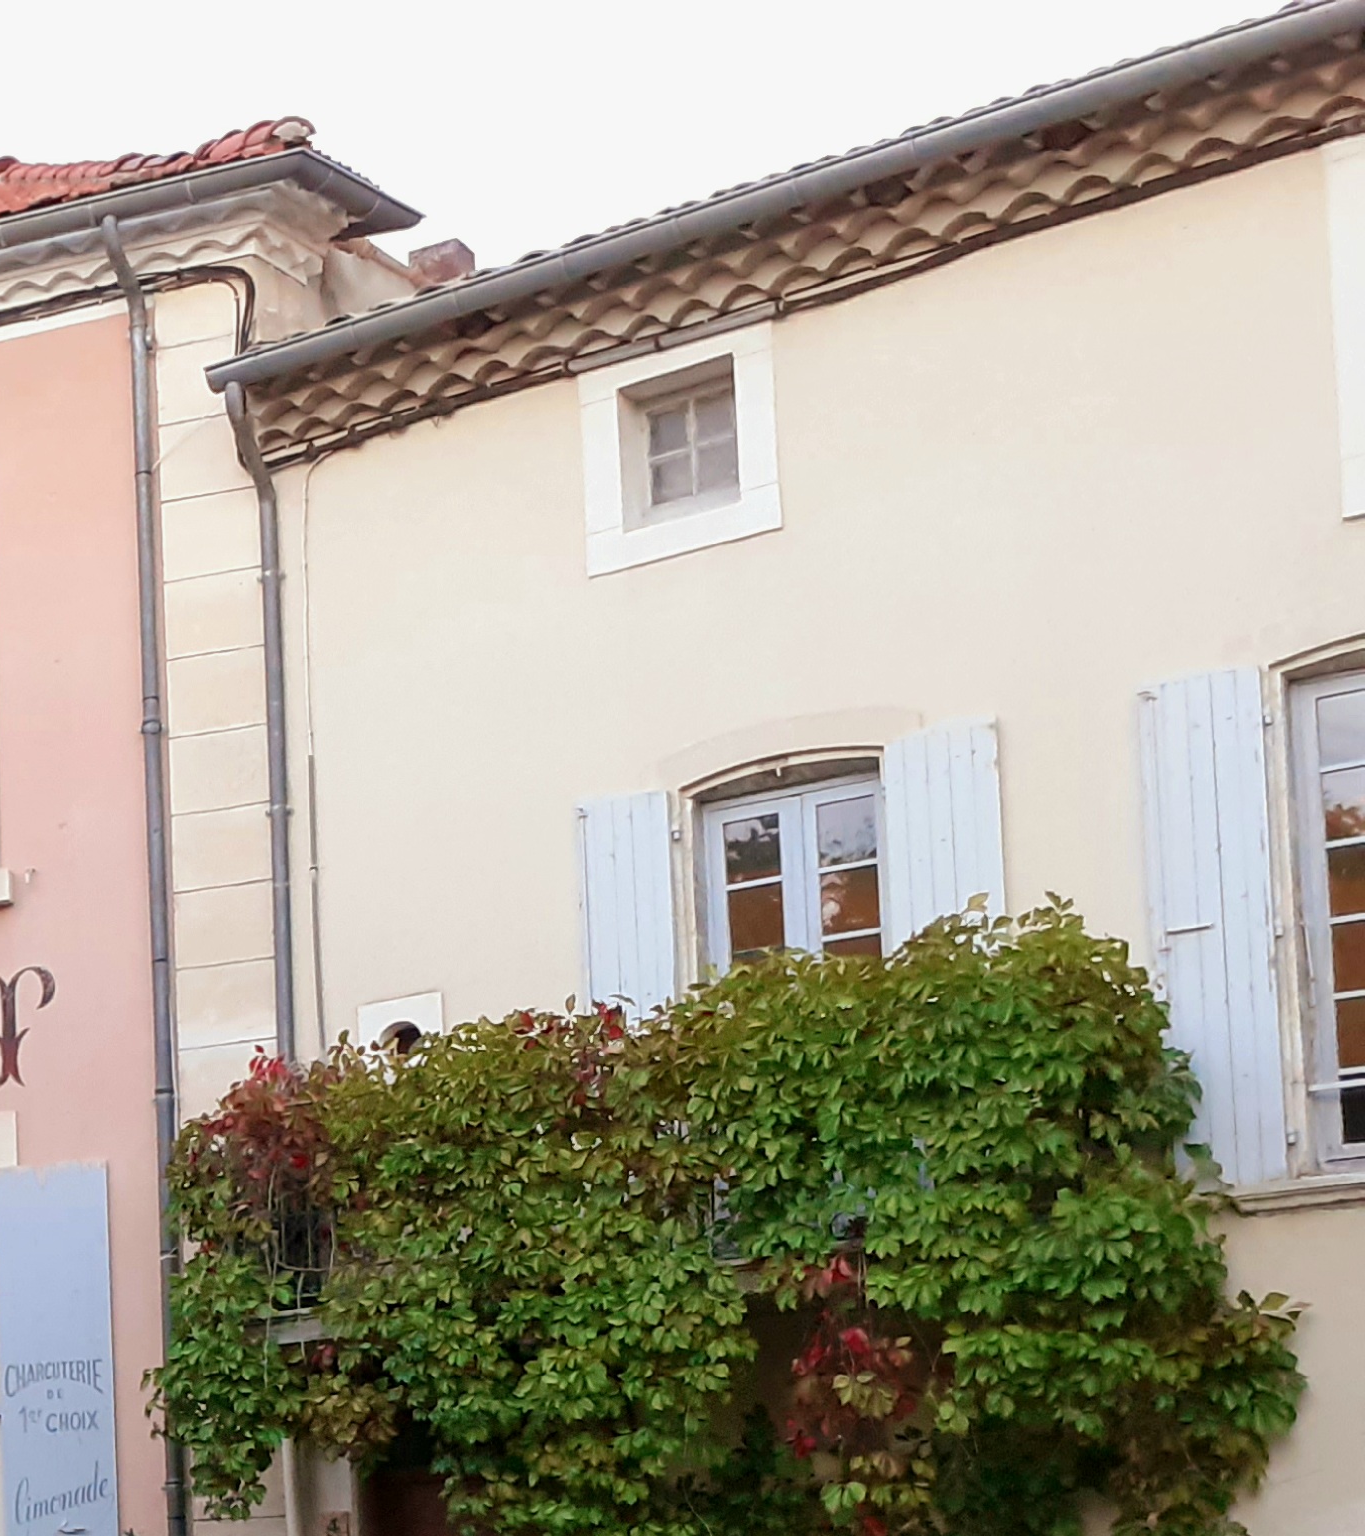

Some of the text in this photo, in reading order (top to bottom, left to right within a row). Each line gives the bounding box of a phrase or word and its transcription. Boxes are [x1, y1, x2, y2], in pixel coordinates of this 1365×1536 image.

[5, 1359, 104, 1397] CHARCUTERIE
[47, 1388, 62, 1399] DE
[46, 1410, 99, 1433] CHOIX
